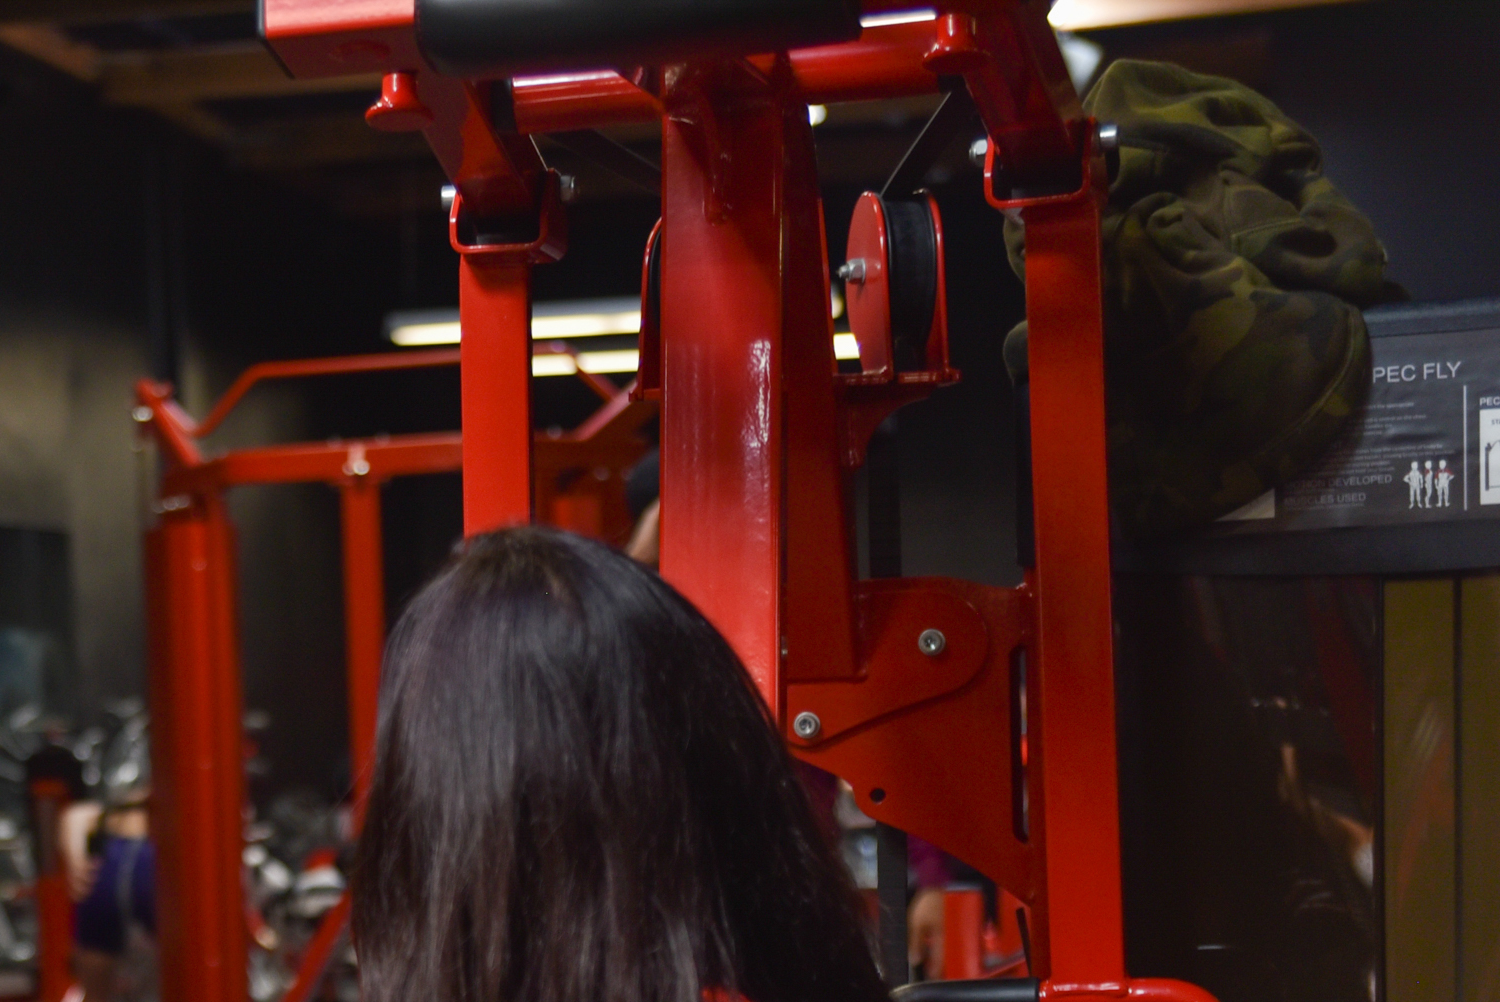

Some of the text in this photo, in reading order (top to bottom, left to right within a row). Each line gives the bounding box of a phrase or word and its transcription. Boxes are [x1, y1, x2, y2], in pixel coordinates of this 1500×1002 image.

[1372, 361, 1462, 384] PEC FLY
[1479, 396, 1500, 407] PEC
[1328, 474, 1392, 487] DEVELOPED
[1336, 492, 1367, 503] USED
